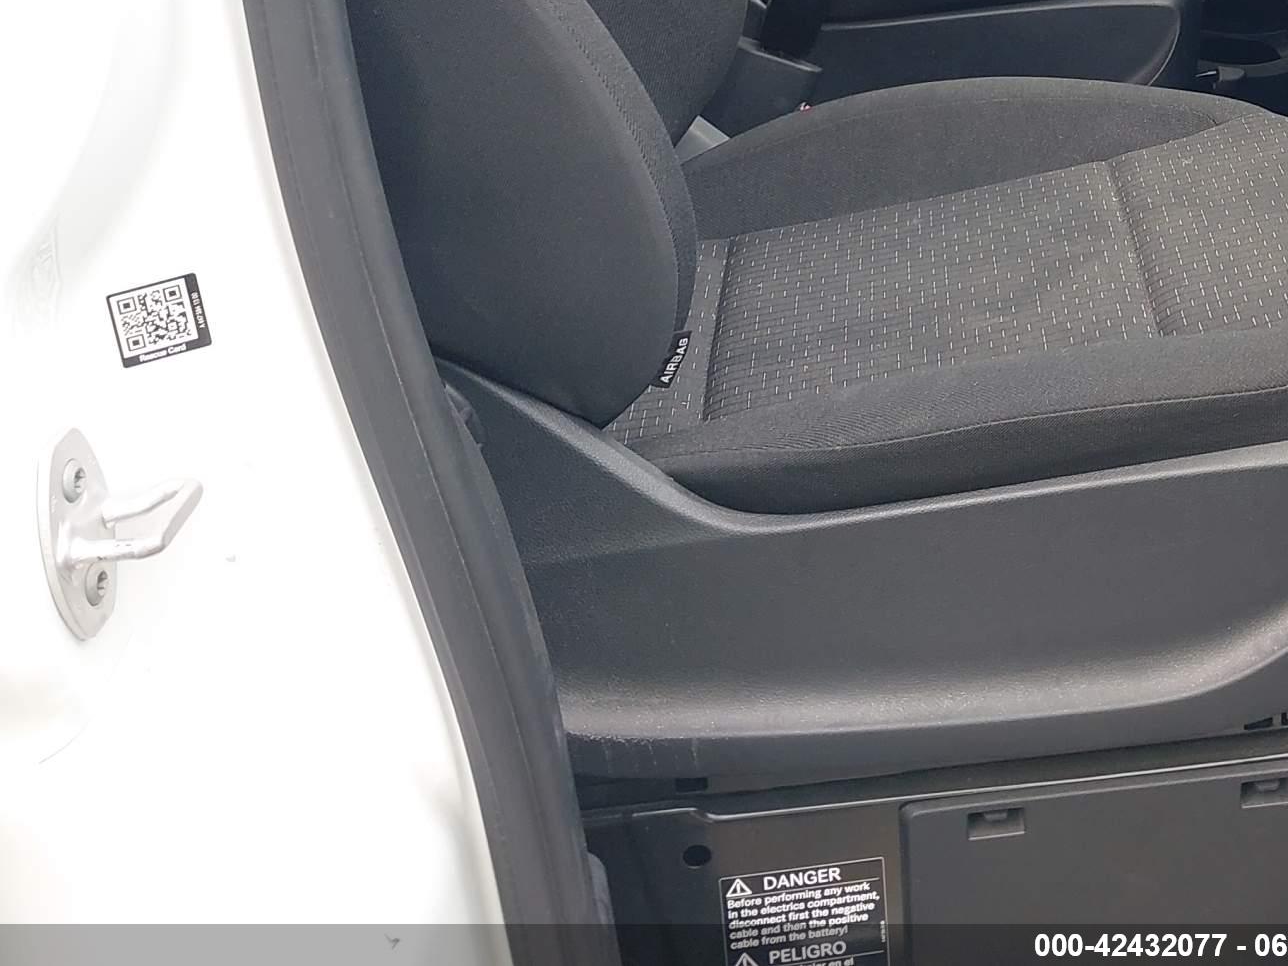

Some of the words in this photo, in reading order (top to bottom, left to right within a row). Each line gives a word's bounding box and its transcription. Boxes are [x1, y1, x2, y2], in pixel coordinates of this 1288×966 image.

[660, 337, 689, 383] AIRBAG
[763, 867, 842, 891] DANGER
[727, 896, 762, 910] Before
[764, 889, 822, 907] performing
[824, 886, 843, 897] any
[844, 881, 870, 894] work
[728, 909, 739, 920] in
[740, 908, 758, 918] the
[760, 900, 806, 915] electrics
[807, 890, 880, 908] compartment,
[728, 913, 787, 930] disconnect
[788, 910, 810, 922] first
[811, 908, 829, 919] the
[831, 902, 876, 916] negative
[729, 928, 759, 940] cable
[760, 924, 781, 936] and
[783, 921, 807, 933] then
[808, 918, 827, 929] the
[828, 912, 869, 928] positive
[730, 938, 760, 950] cable
[761, 934, 787, 946] from
[788, 931, 807, 942] the
[807, 924, 848, 941] battery!
[769, 940, 846, 964] PELIGRO
